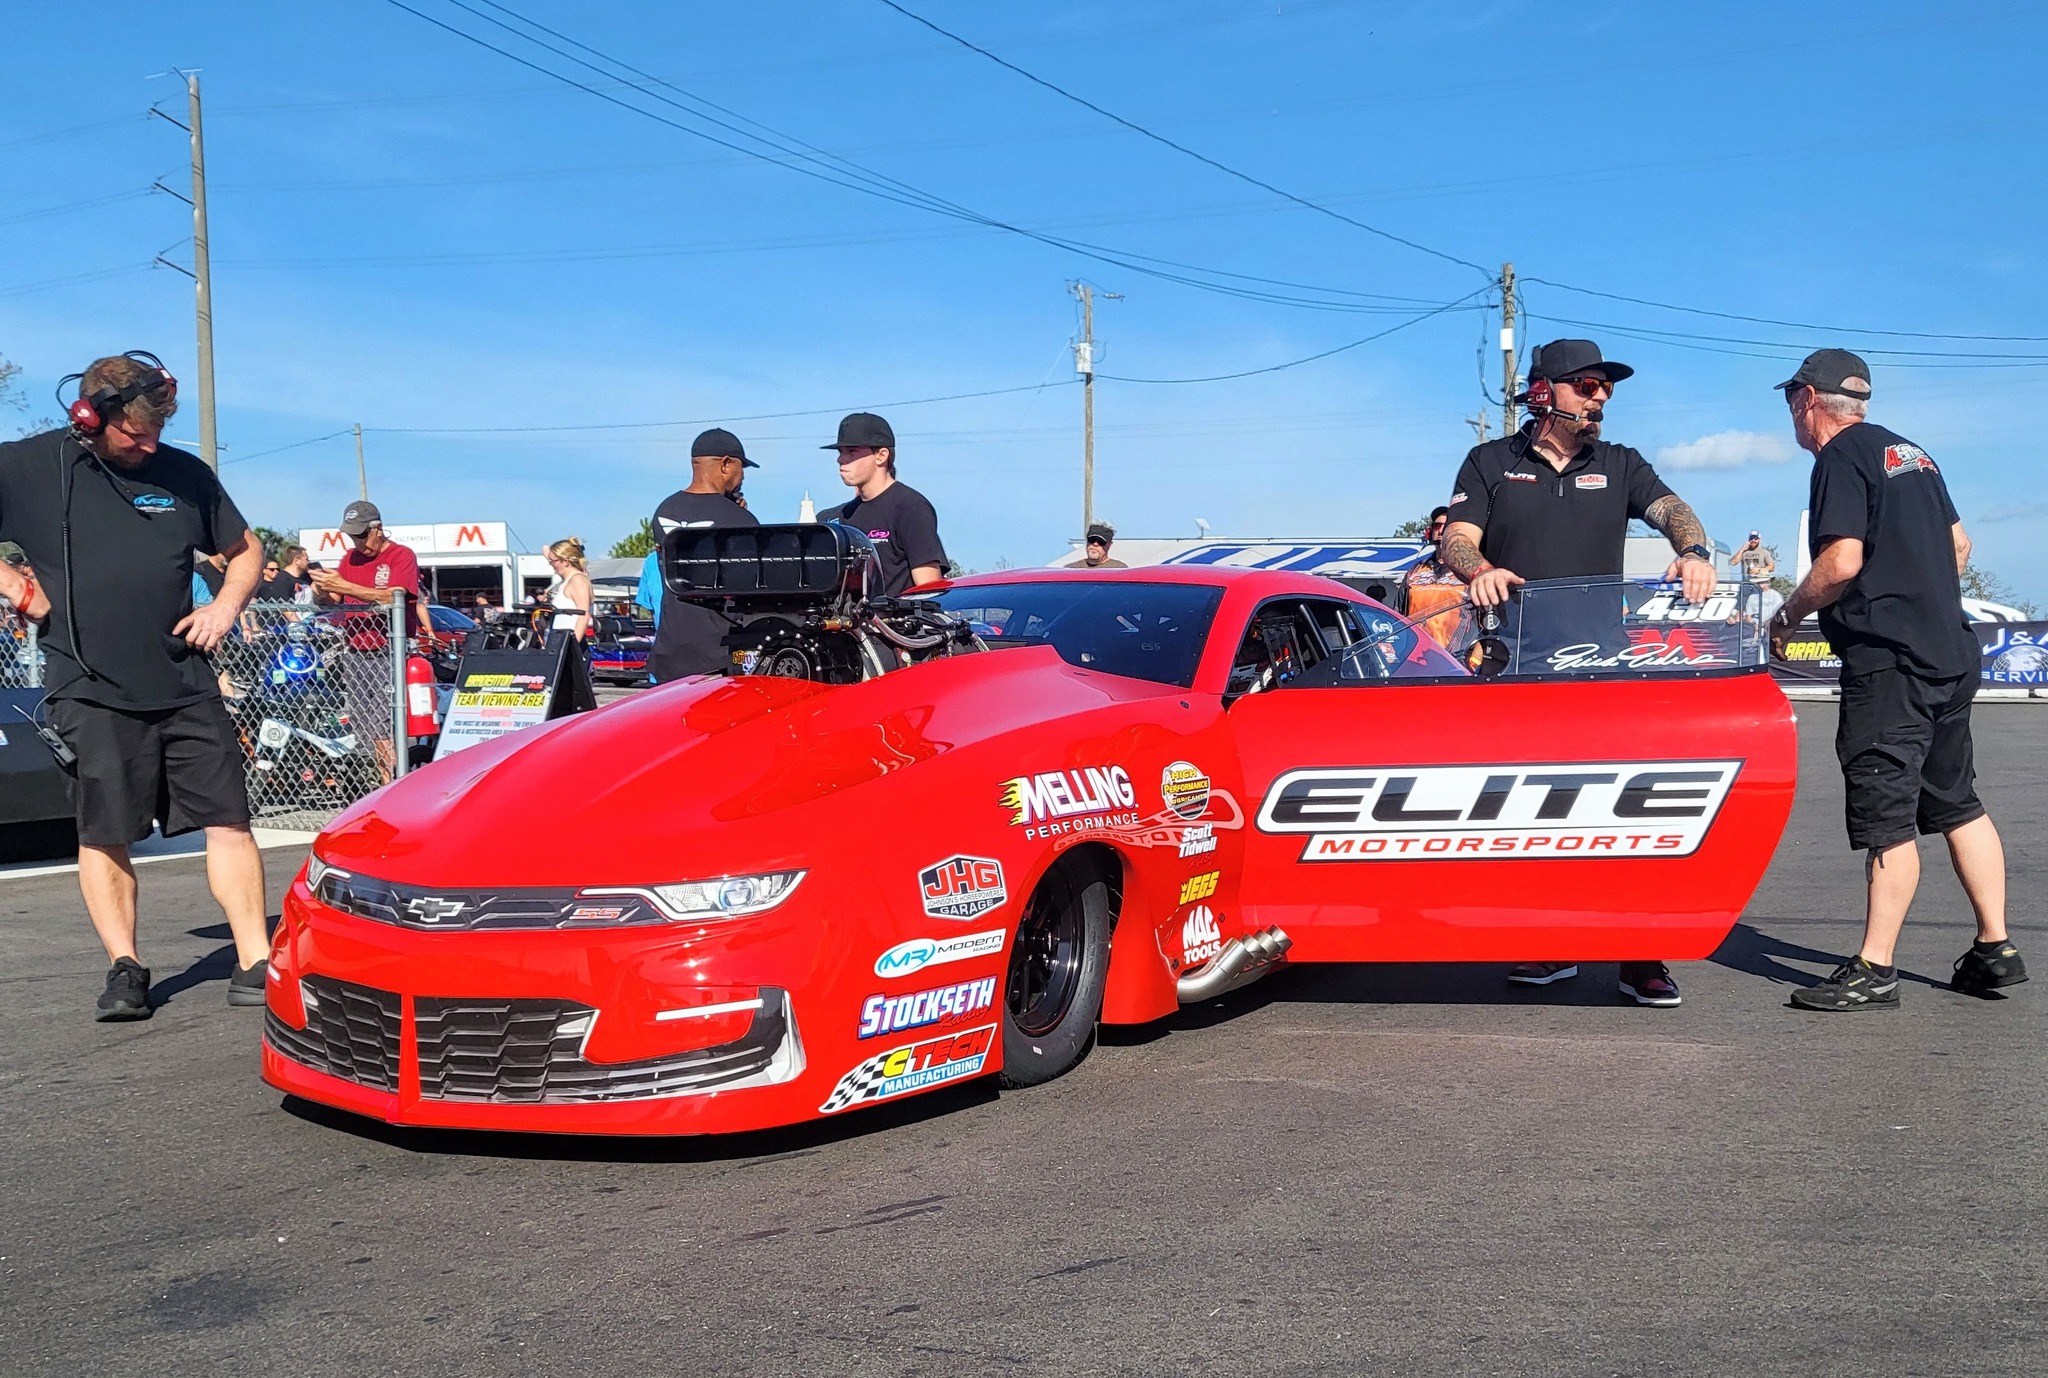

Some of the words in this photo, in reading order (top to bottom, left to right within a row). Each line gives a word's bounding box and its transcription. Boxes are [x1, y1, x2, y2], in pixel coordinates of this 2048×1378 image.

[1981, 670, 2048, 683] SERVI
[455, 694, 479, 706] TEAM
[481, 694, 520, 707] VIEWING
[521, 694, 545, 707] AREA
[1170, 768, 1197, 781] HIGH
[1163, 780, 1208, 794] PERFORMANCE
[1270, 771, 1725, 824] ELITE
[1025, 812, 1140, 841] PERFORMANCE
[1182, 822, 1214, 842] Scott
[1178, 836, 1218, 858] Tidwell
[1318, 834, 1686, 854] MOTORSPORTS
[924, 861, 1001, 899] JHG
[1180, 870, 1220, 905] JEGS
[926, 896, 959, 908] JOHNSON'S
[940, 898, 994, 915] GARAGE
[1182, 904, 1221, 950] MAC
[972, 943, 1001, 953] RACING
[1184, 940, 1221, 965] TOOLS
[858, 976, 997, 1039] STOCKSETH
[884, 1058, 980, 1094] MANUFACTURING
